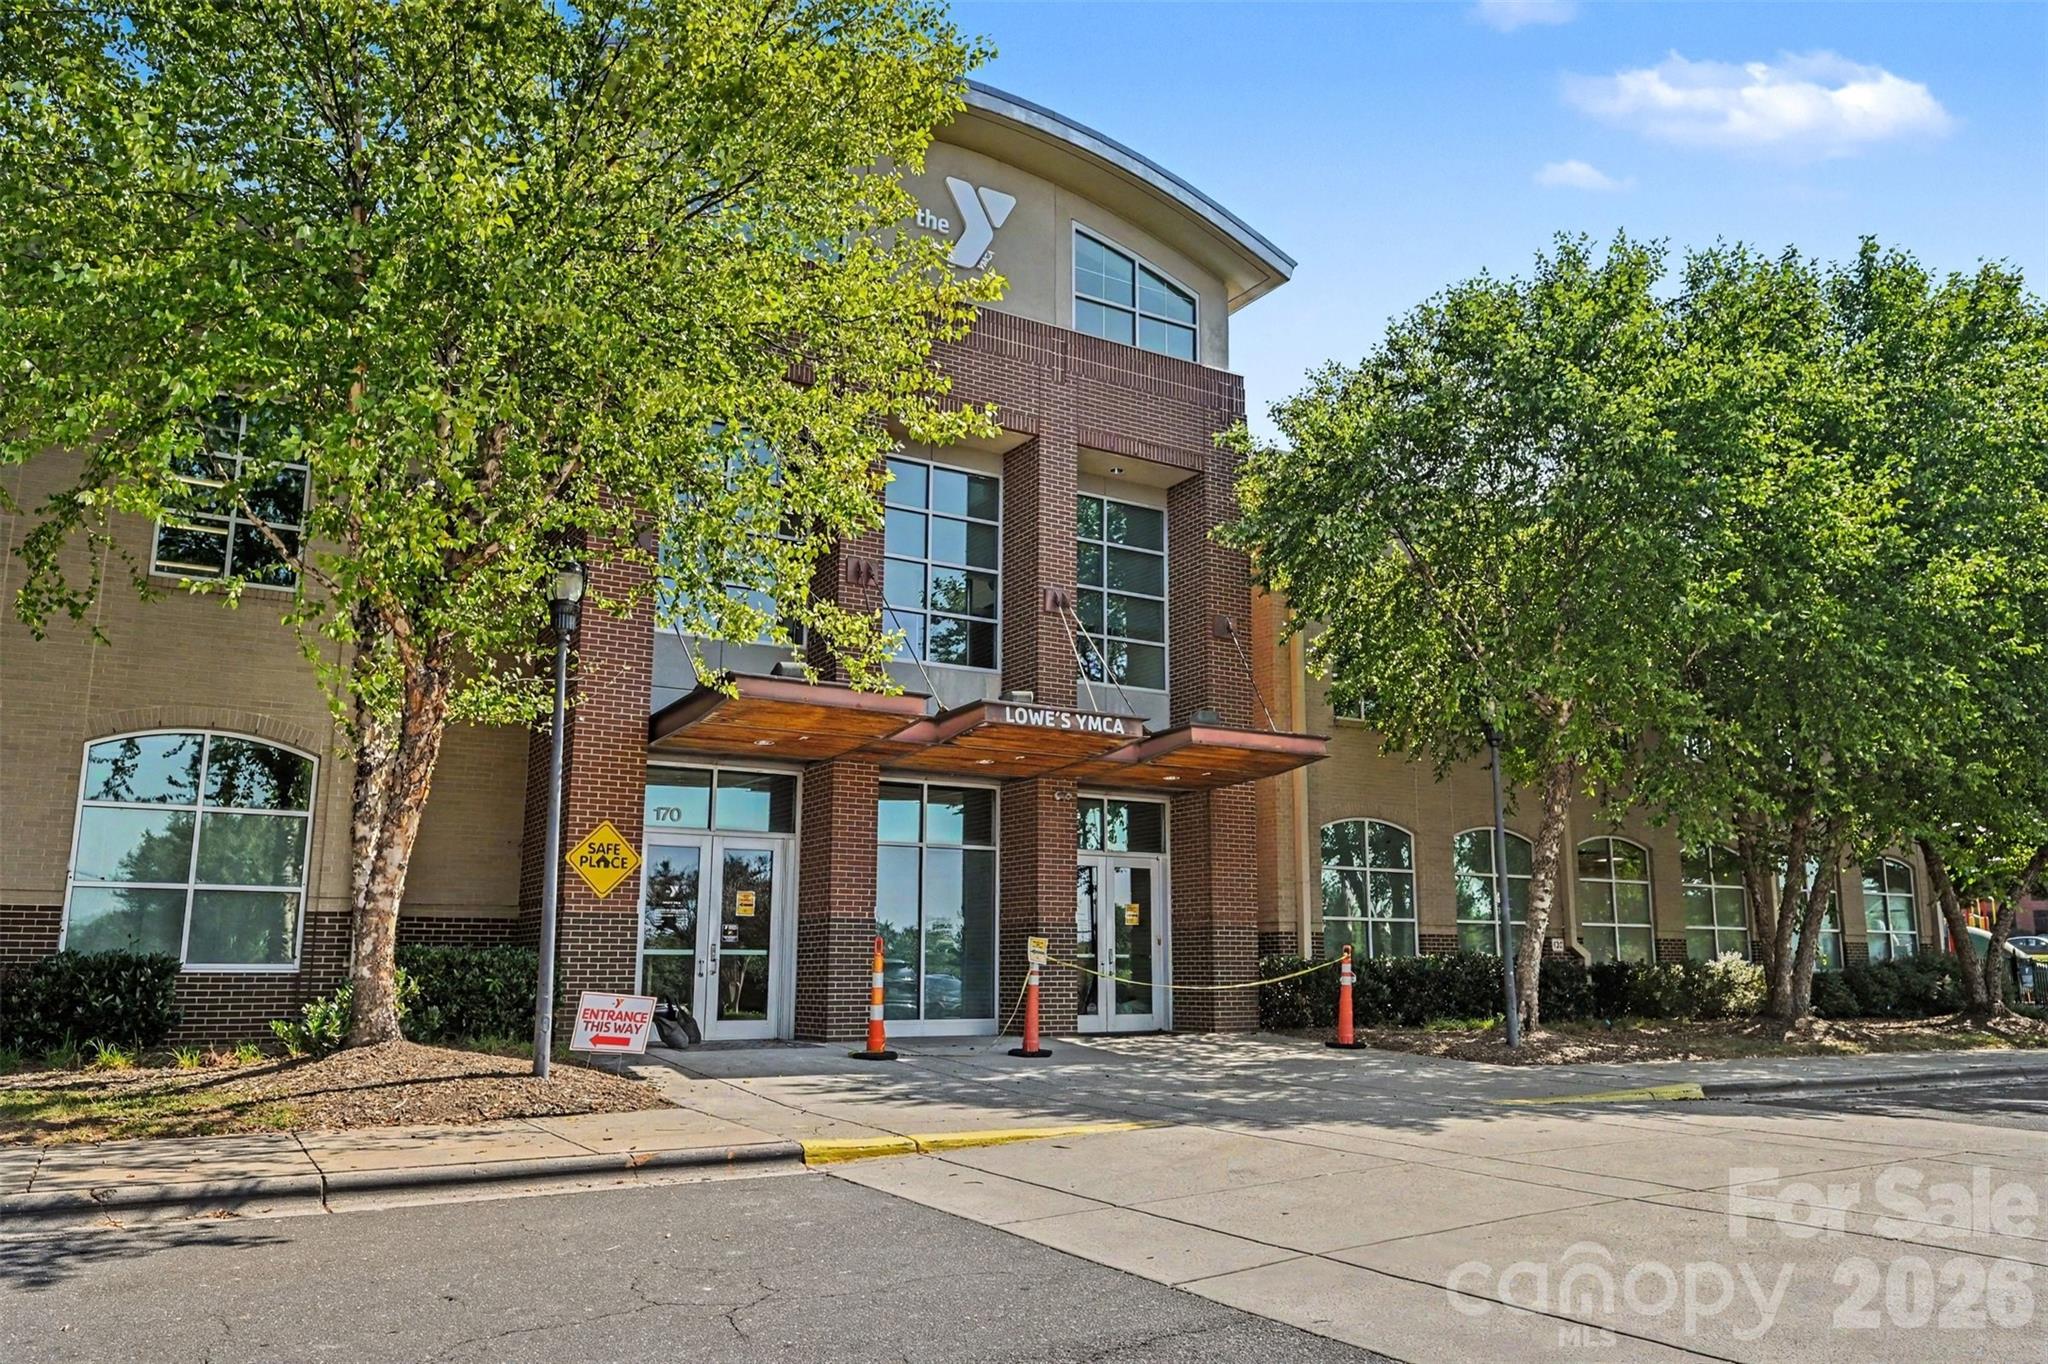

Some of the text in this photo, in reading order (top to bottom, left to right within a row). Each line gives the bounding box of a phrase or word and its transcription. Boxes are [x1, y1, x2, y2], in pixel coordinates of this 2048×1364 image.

[916, 208, 950, 234] the
[1005, 706, 1125, 735] LOWE'S YMCA
[653, 806, 682, 822] 170
[587, 842, 621, 856] SAFE
[581, 1008, 649, 1024] ENTRANCE
[583, 1020, 644, 1035] THIS WAY
